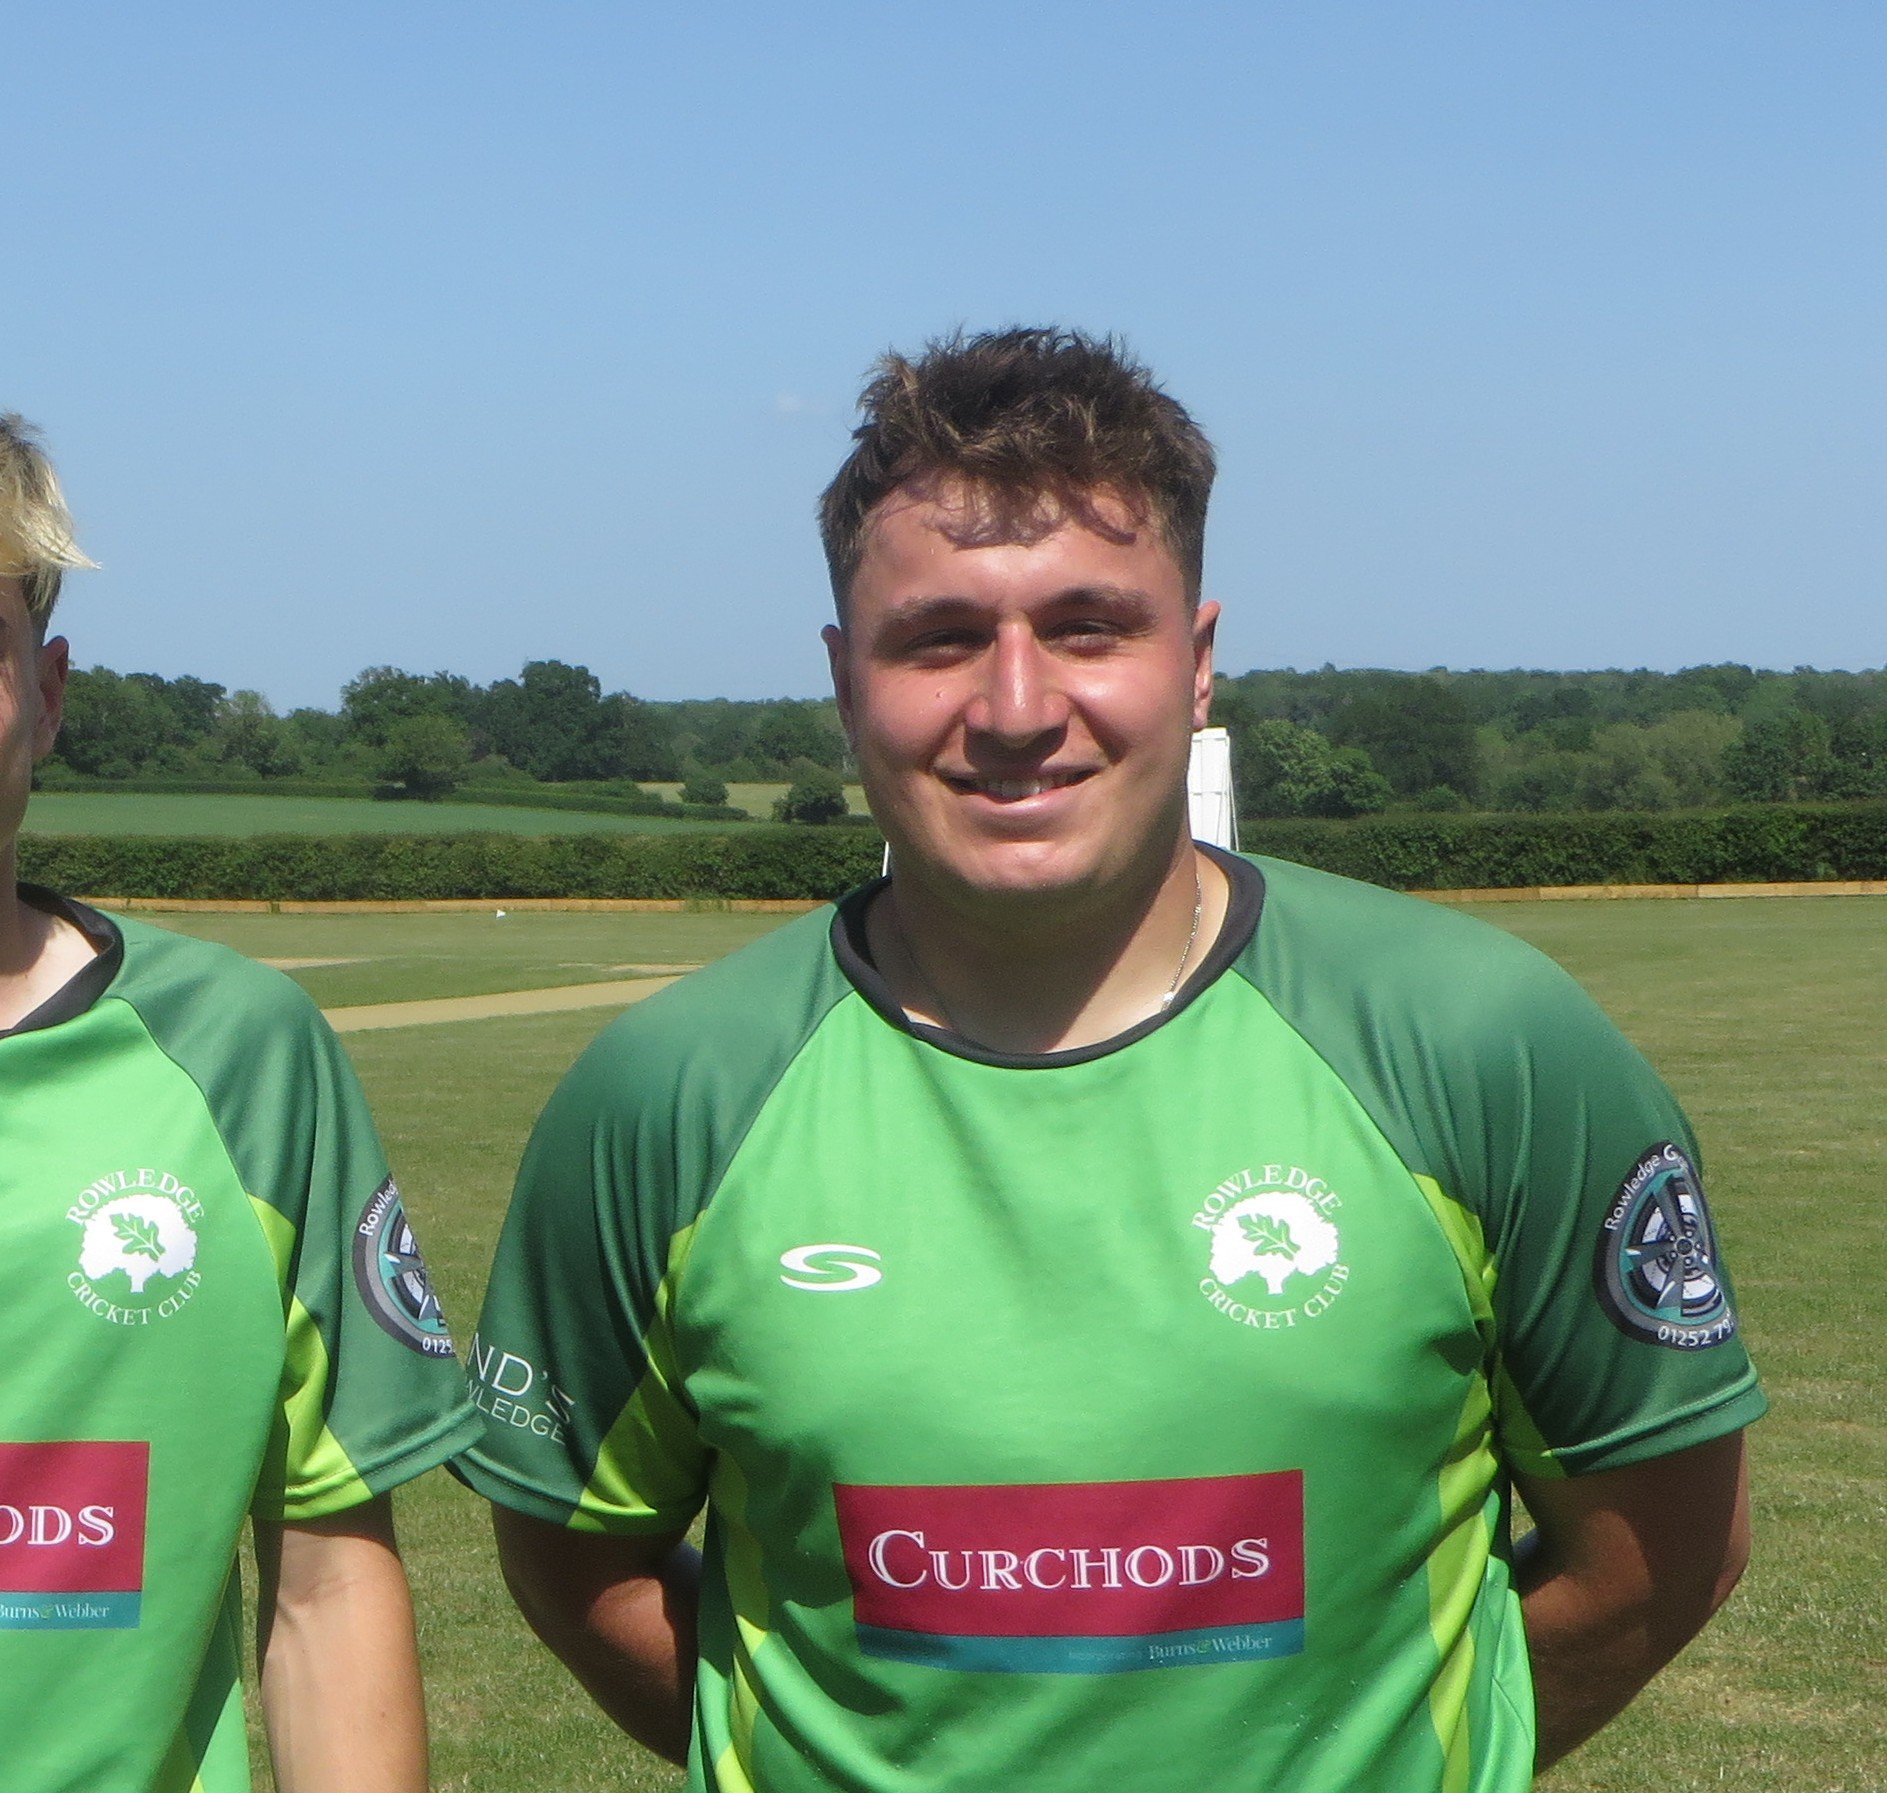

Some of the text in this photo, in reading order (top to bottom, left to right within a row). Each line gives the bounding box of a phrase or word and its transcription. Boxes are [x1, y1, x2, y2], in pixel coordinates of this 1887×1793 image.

[65, 1167, 205, 1226] ROWLEDGE
[1191, 1164, 1343, 1231] ROWLEDGE
[66, 1270, 203, 1326] CRICKET CLUB
[1198, 1262, 1350, 1330] CRICKET CLUB
[1657, 1324, 1712, 1348] 01252
[867, 1529, 1271, 1591] CURCHODS
